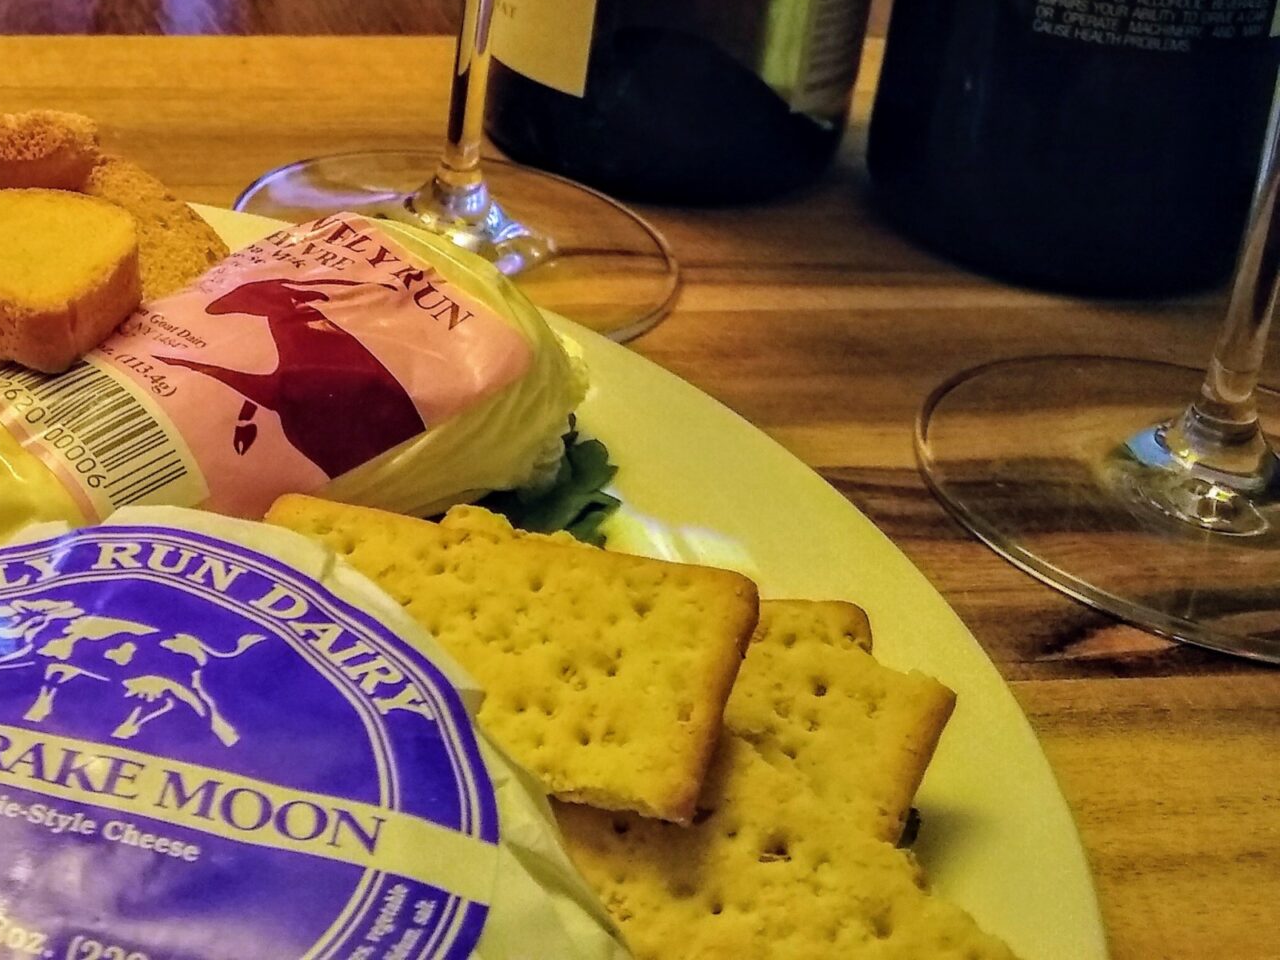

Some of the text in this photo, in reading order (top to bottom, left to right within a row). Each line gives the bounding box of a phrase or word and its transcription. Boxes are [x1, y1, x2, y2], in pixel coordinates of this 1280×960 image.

[390, 262, 475, 332] RUN
[150, 312, 181, 337] Goat
[177, 324, 208, 350] Dairy
[115, 351, 179, 398] (113.4g)
[43, 427, 107, 490] 00006
[91, 542, 247, 593] RUN
[249, 582, 437, 721] DAIRY
[101, 819, 202, 862] Cheese
[155, 768, 387, 856] MOON
